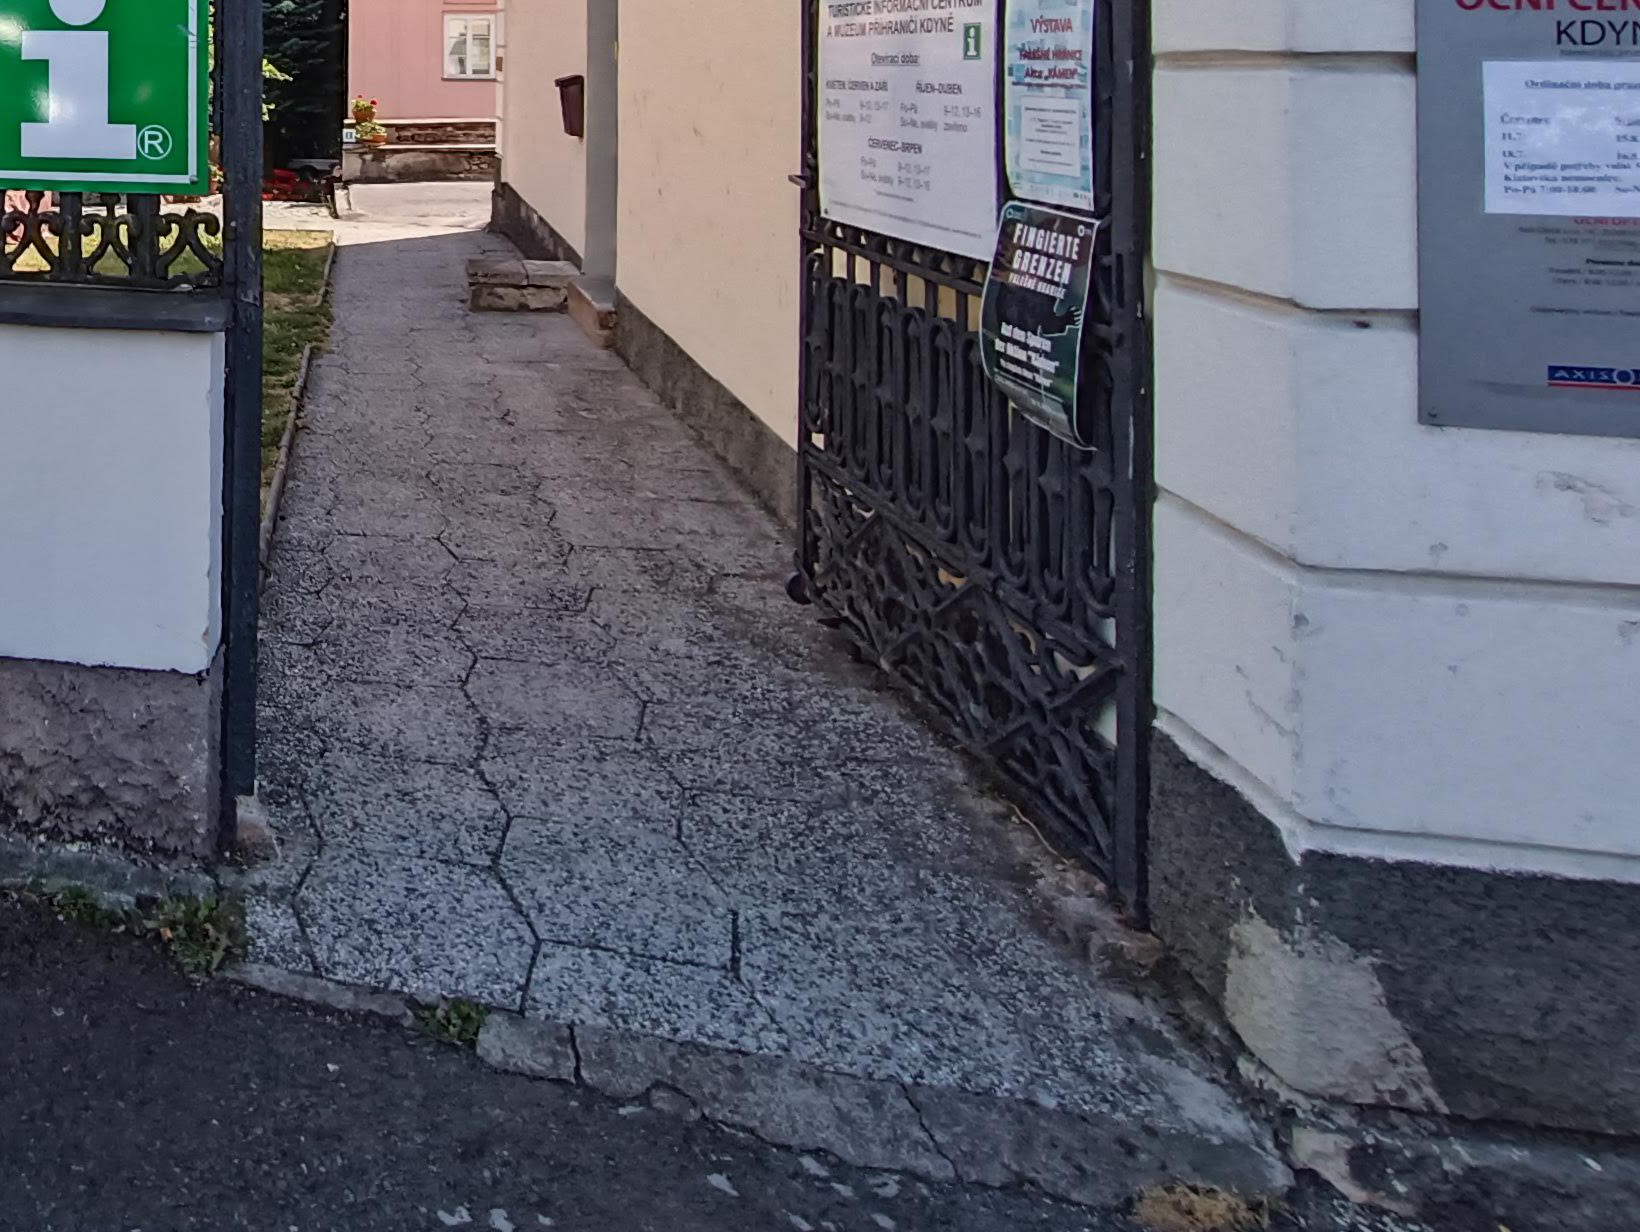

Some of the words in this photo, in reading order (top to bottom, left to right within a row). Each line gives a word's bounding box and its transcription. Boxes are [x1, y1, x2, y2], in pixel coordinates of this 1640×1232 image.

[1030, 15, 1073, 33] VÝSTAVA
[1013, 223, 1080, 260] FINGIERTE
[1012, 249, 1072, 284] GRENZEN
